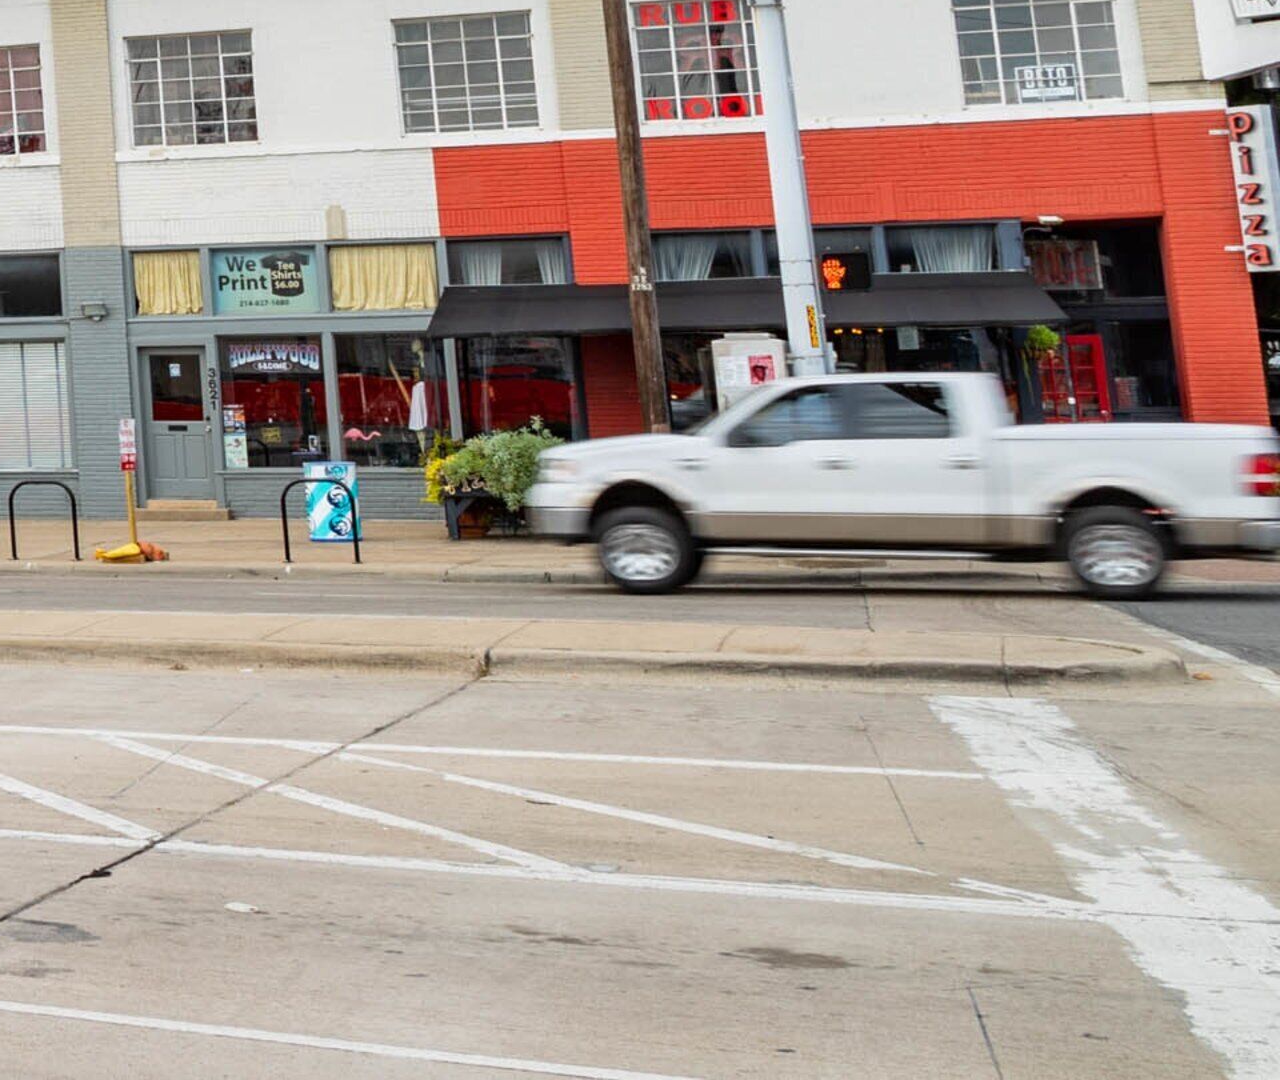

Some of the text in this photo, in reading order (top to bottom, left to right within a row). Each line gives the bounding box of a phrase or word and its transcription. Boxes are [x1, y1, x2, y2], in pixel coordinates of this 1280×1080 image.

[639, 0, 738, 27] RUB
[1024, 67, 1068, 88] BETO
[1228, 111, 1273, 265] pizza
[225, 256, 256, 272] We
[276, 260, 295, 270] Tee
[218, 274, 268, 291] Print
[271, 270, 301, 281] Shirts
[274, 280, 300, 289] $6.00
[228, 343, 320, 371] HOLLYWOOD
[208, 367, 219, 410] 3621
